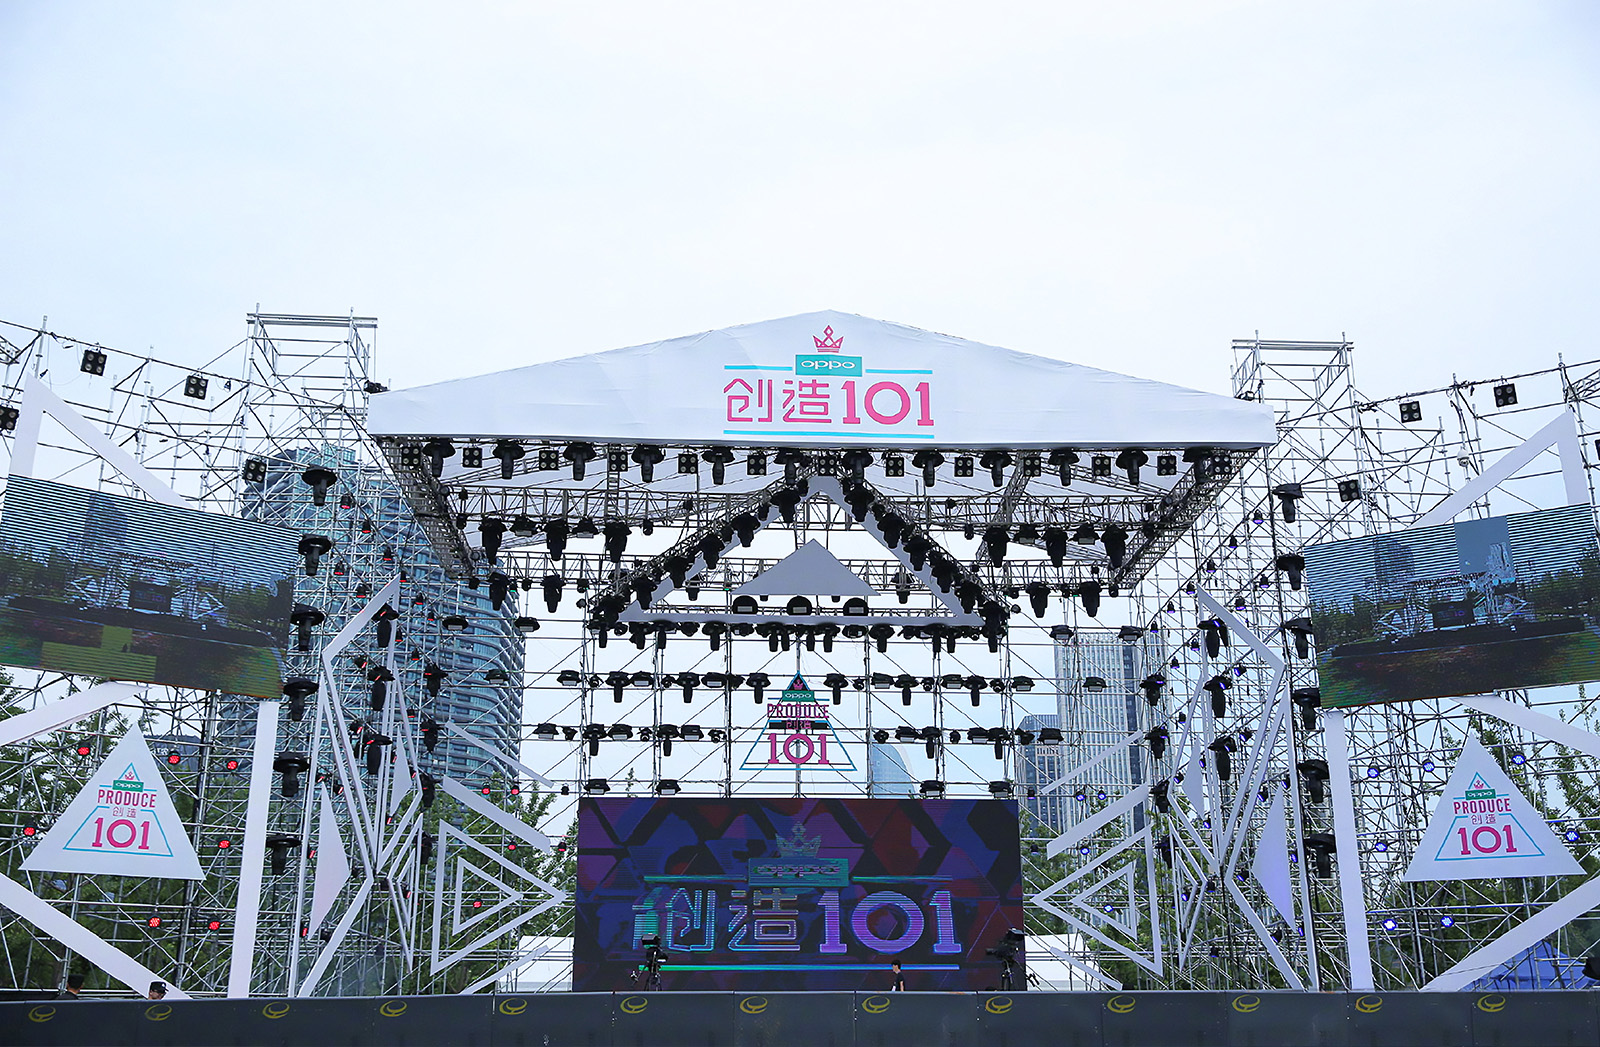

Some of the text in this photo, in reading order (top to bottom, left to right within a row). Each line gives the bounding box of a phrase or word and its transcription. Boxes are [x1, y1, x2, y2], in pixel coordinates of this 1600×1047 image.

[801, 360, 856, 370] oppo
[767, 703, 830, 718] PRODUCE
[767, 733, 830, 765] 101
[115, 782, 142, 790] oppo
[97, 789, 157, 808] PRODUCE
[1467, 791, 1493, 799] oppo
[1453, 798, 1512, 815] PRODUCE
[1471, 813, 1497, 825] 创造
[91, 817, 150, 851] 101
[1457, 824, 1518, 856] 101
[755, 864, 841, 878] oppo
